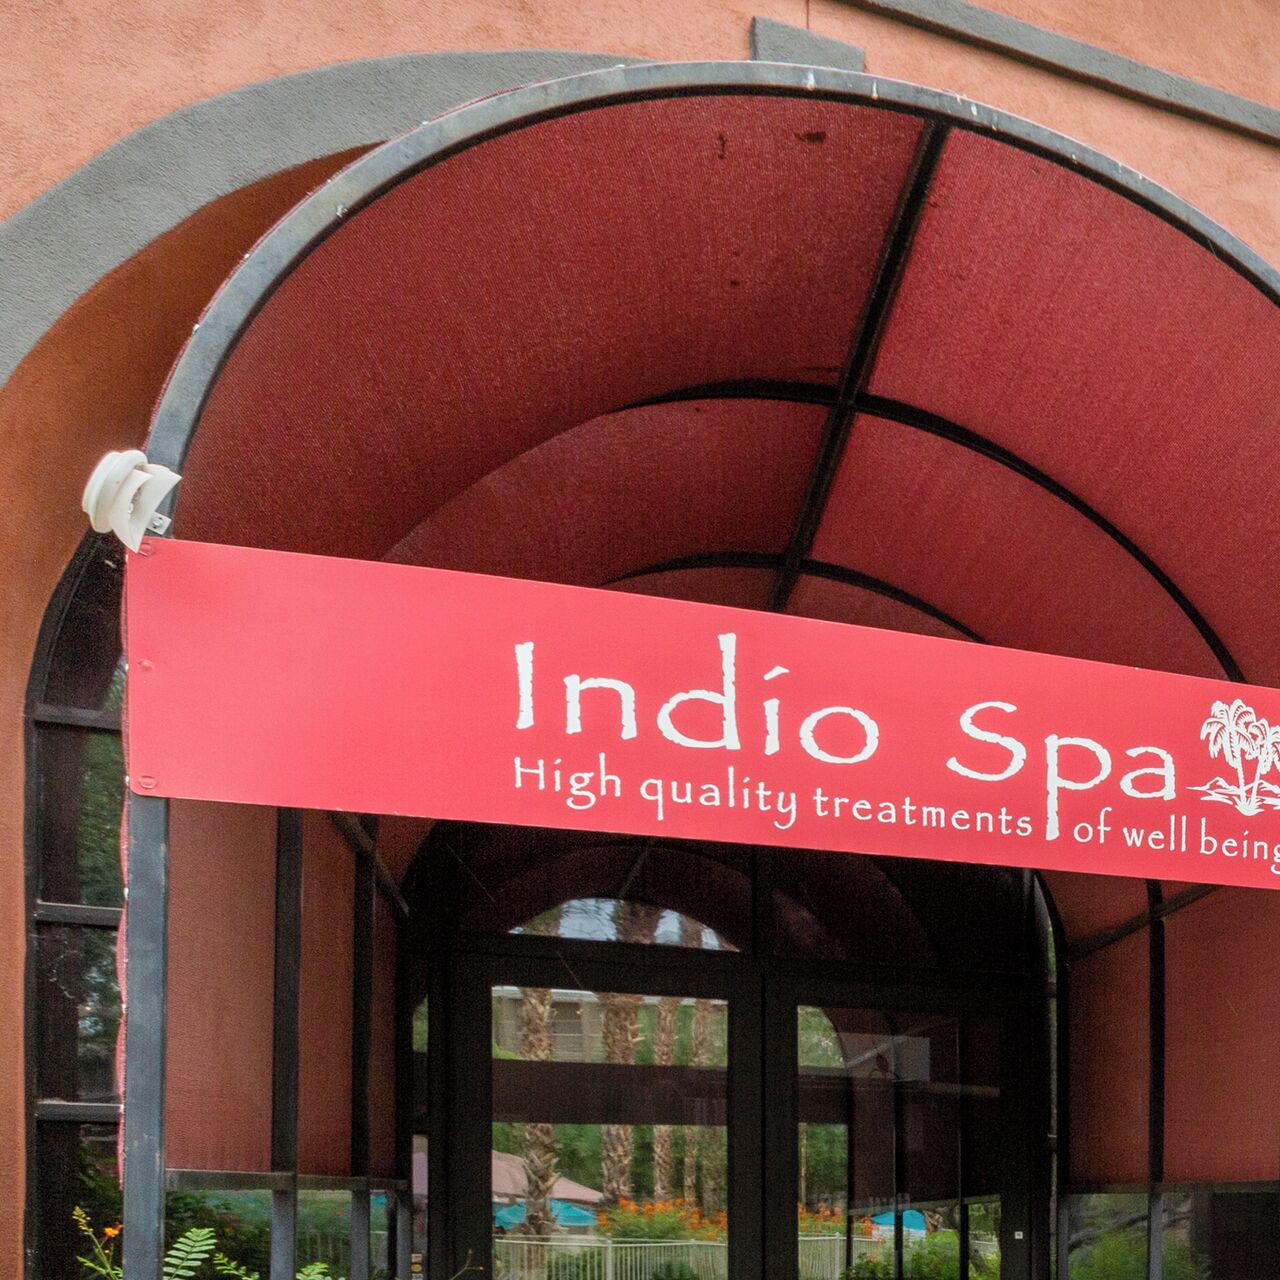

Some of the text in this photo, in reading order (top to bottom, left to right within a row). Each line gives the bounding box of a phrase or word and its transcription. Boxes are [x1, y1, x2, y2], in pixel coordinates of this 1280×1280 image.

[514, 753, 621, 810] High
[639, 766, 797, 830] quality
[812, 788, 1034, 838] treatments
[1073, 806, 1113, 845] of
[1122, 814, 1189, 852] well
[946, 702, 1177, 841] Spa
